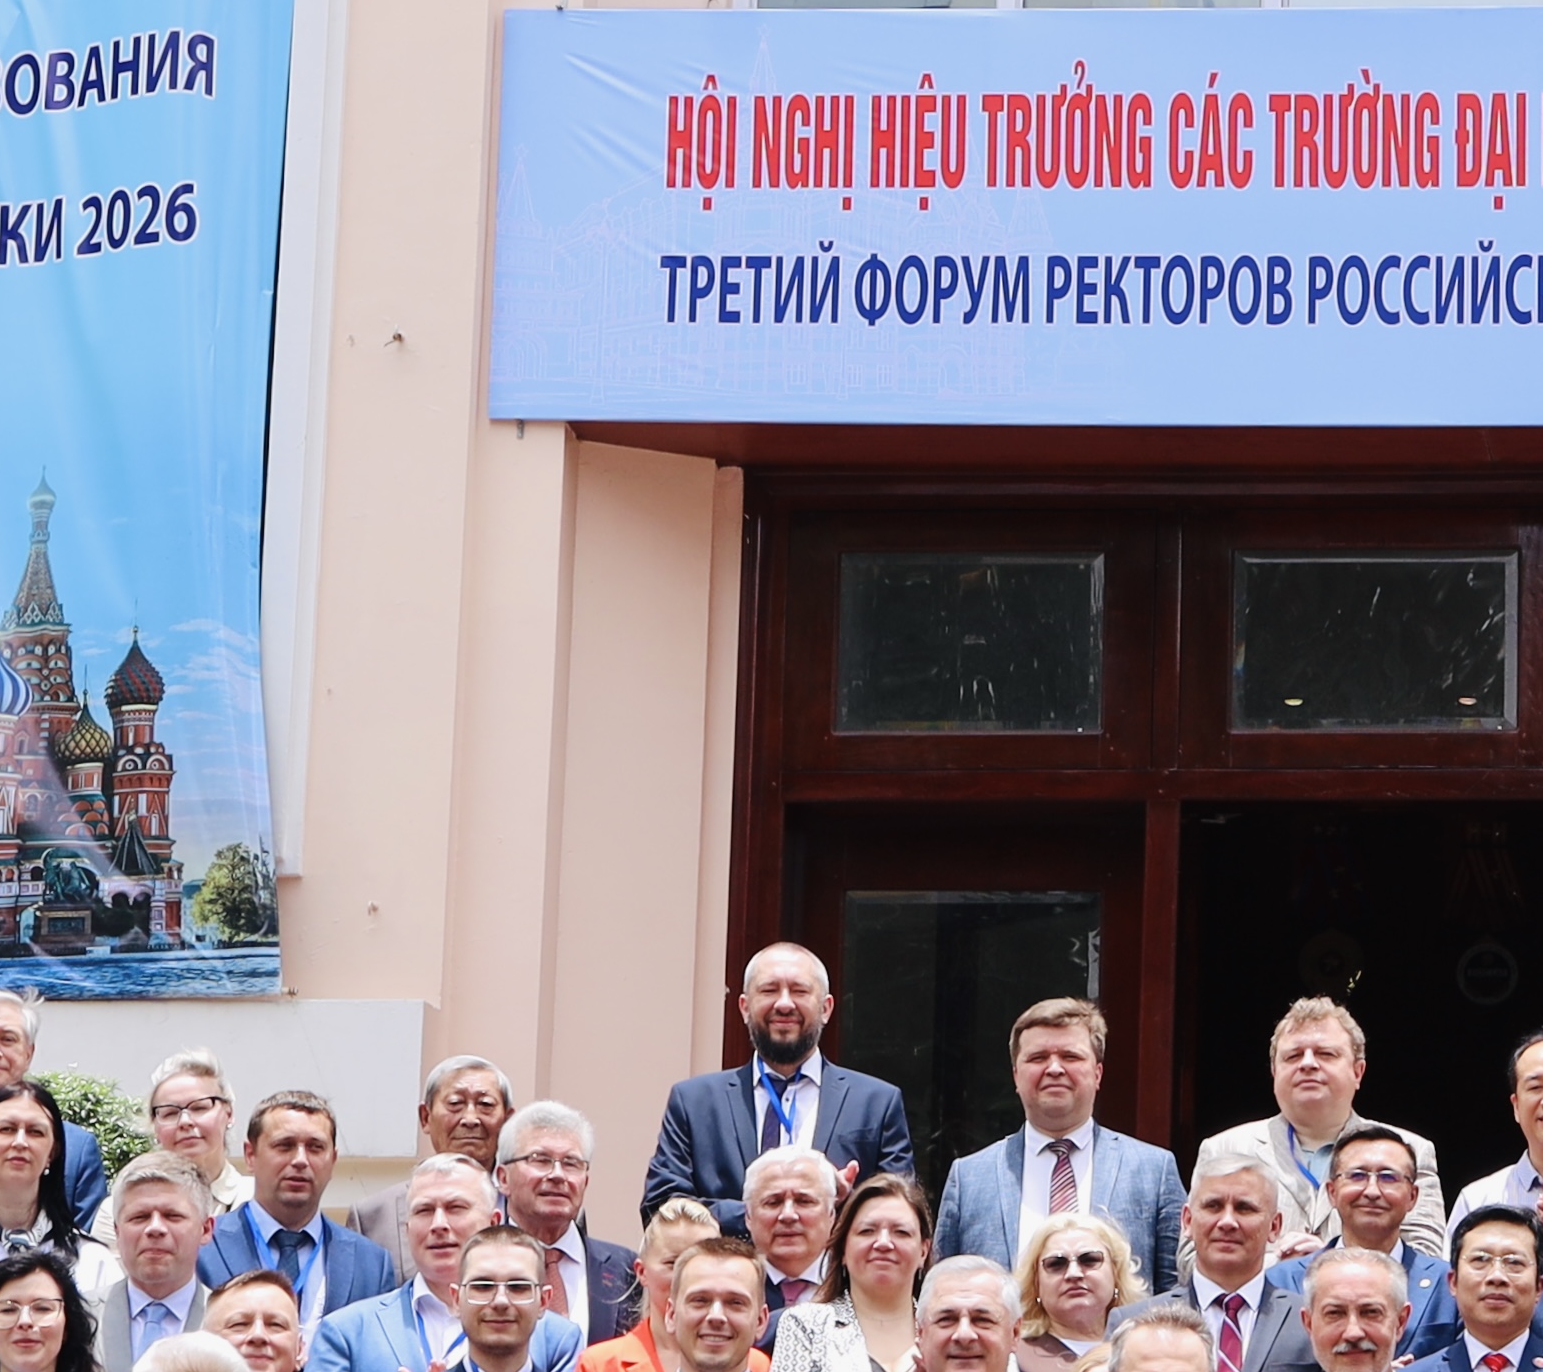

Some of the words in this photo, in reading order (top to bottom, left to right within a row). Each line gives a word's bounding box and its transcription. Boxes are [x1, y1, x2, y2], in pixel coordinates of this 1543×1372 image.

[665, 73, 739, 213] HỘI
[751, 92, 857, 213] NGHỊ
[868, 72, 969, 212] HIỆU
[980, 59, 1154, 191] TRƯỞNG
[1167, 71, 1256, 191] CÁC
[1267, 67, 1442, 191] TRƯỜNG
[1454, 91, 1528, 211] ĐẠI
[76, 182, 198, 256] 2026
[659, 239, 841, 325] ТРЕТИЙ
[853, 252, 1031, 328] ФОРУМ
[1045, 253, 1294, 327] РЕКТОРОВ
